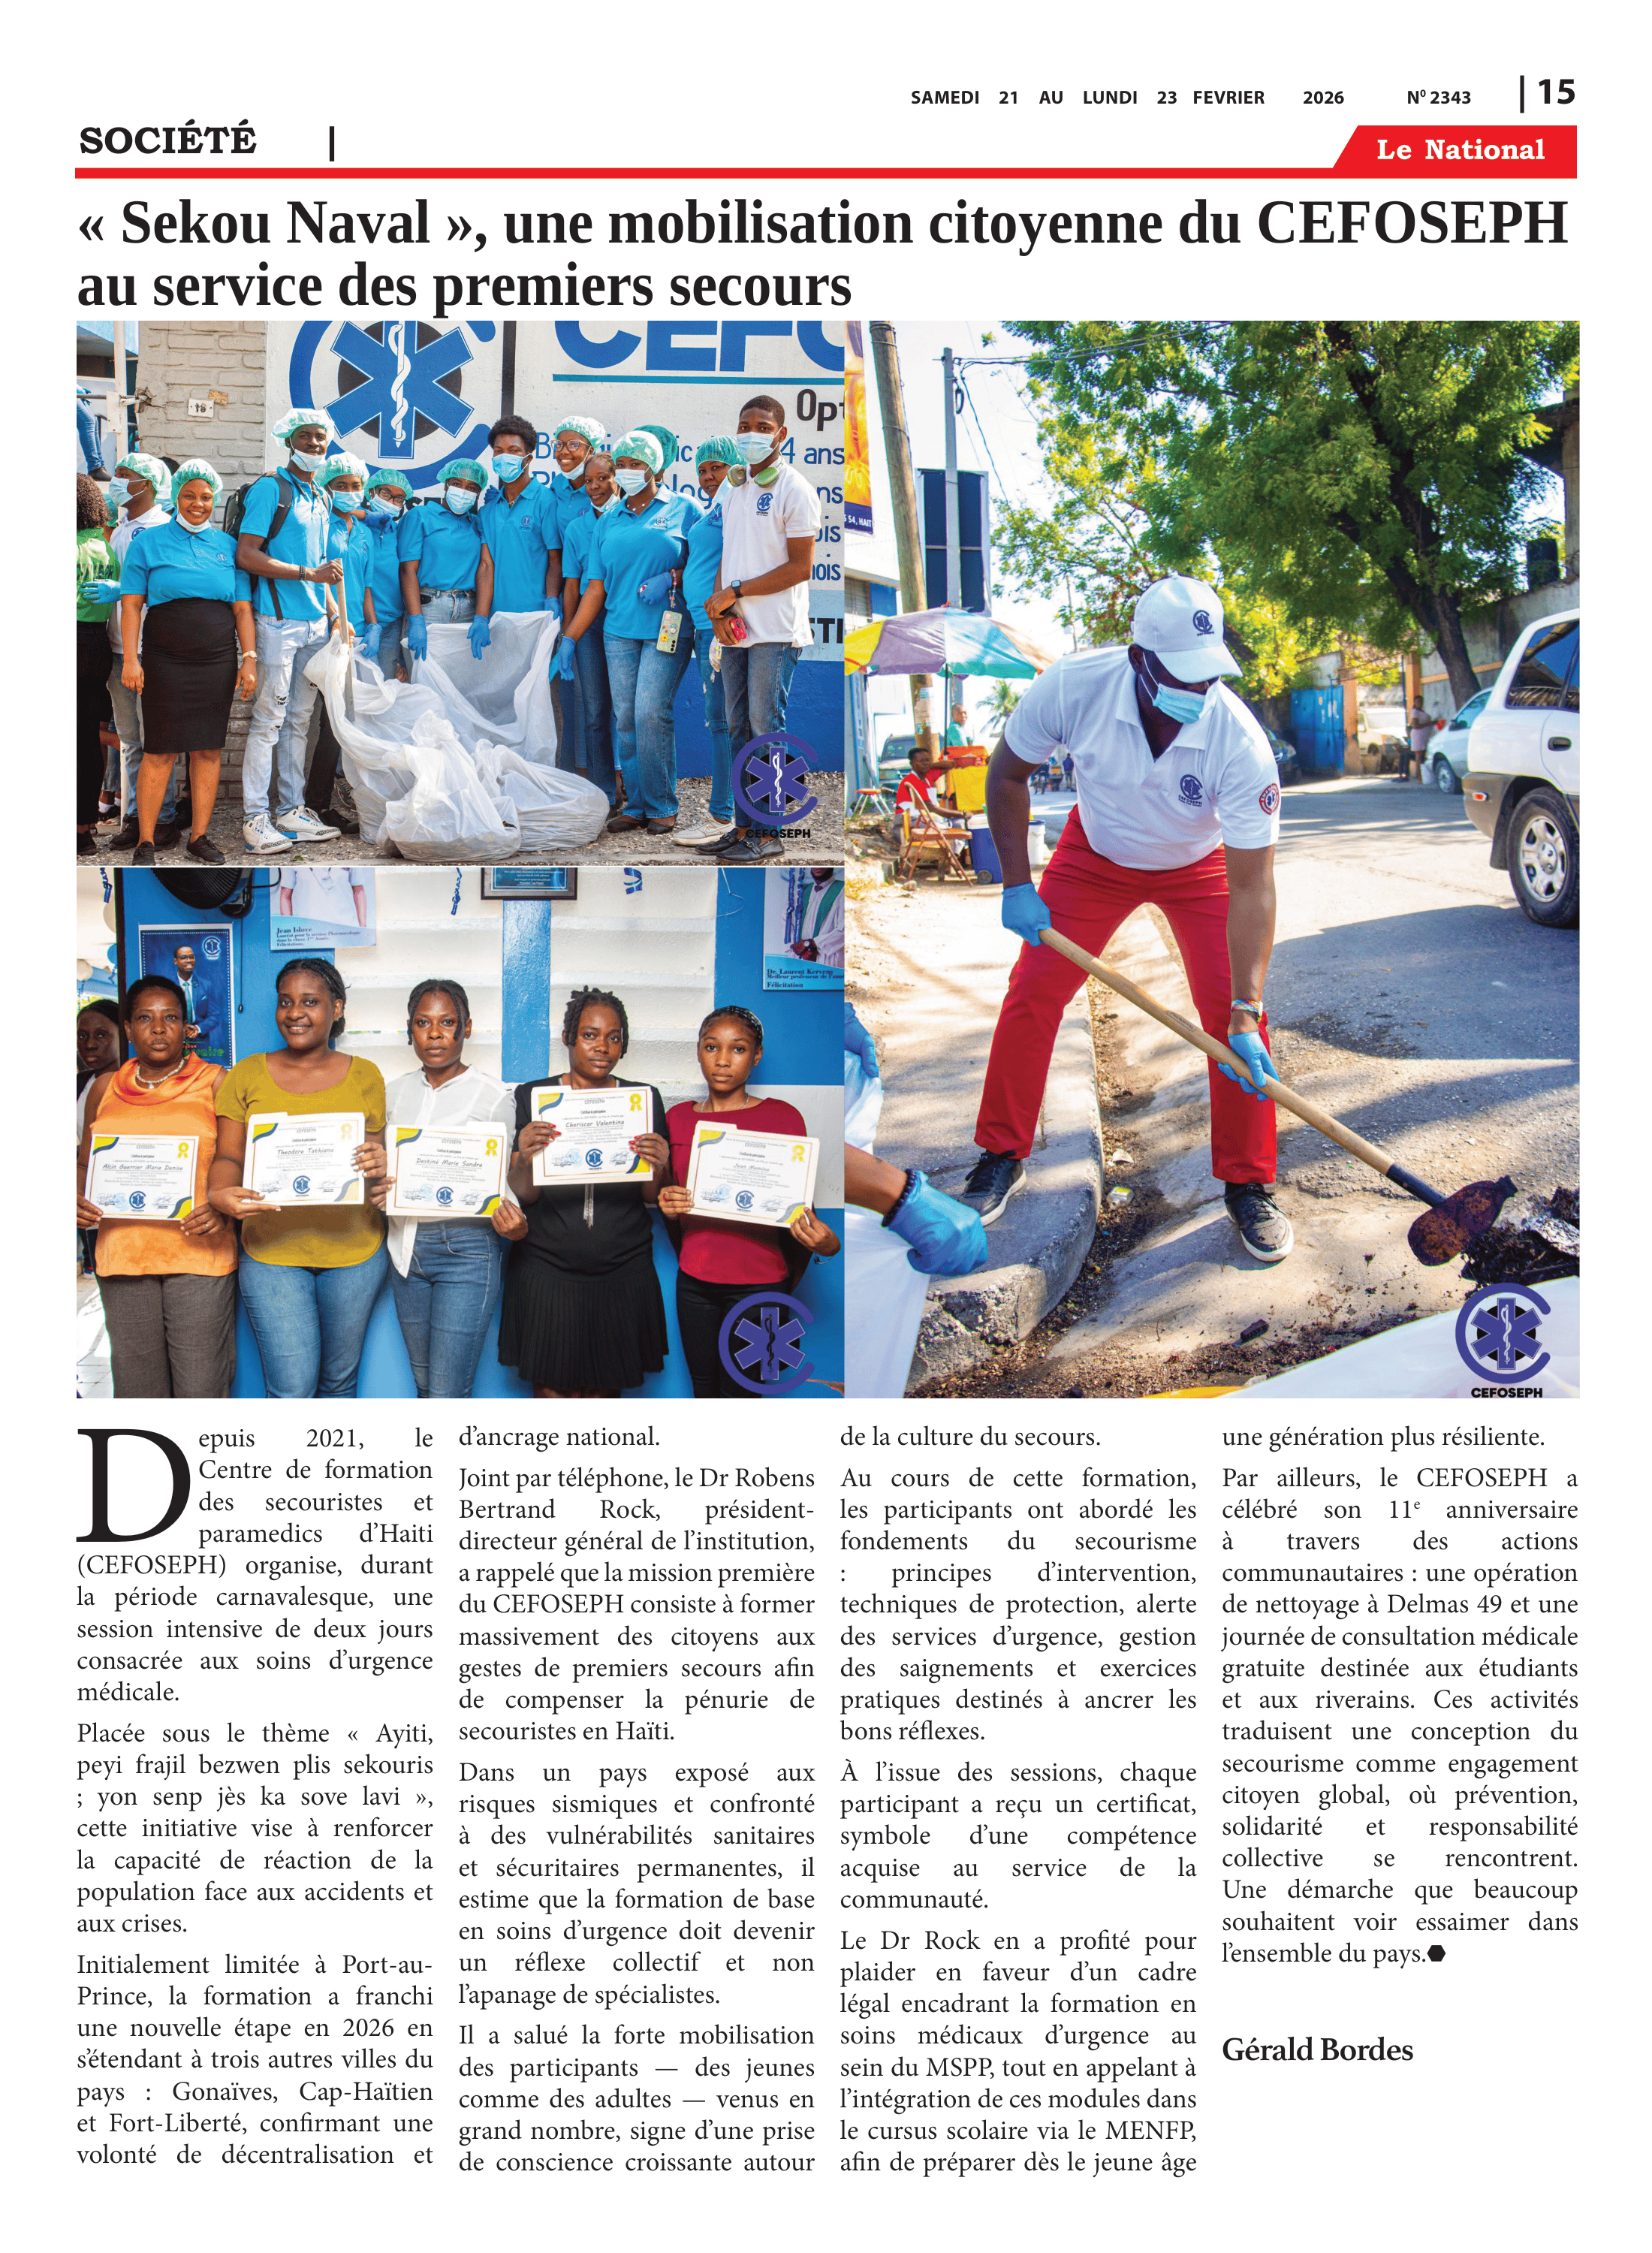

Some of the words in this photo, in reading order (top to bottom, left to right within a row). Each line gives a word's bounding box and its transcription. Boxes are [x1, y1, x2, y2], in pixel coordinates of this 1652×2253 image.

[911, 90, 979, 104] SAMEDI
[999, 91, 1017, 104] 21
[1039, 90, 1063, 104] AU
[1084, 90, 1137, 104] LUNDI
[1157, 91, 1177, 104] 23
[1193, 90, 1265, 104] FEVRIER
[1303, 91, 1345, 104] 2026
[1430, 91, 1471, 104] 2343
[1539, 79, 1575, 104] 15
[80, 119, 258, 155] SOCIÉTÉ
[1377, 139, 1412, 160] Le
[1425, 138, 1545, 160] National
[122, 198, 271, 244] Sekou
[287, 198, 430, 244] Naval
[503, 213, 592, 244] une
[608, 198, 914, 244] mobilisation
[930, 198, 1162, 257] citoyenne
[1179, 198, 1241, 244] du
[1259, 201, 1569, 244] CEFOSEPH
[78, 275, 137, 306] au
[153, 261, 322, 306] service
[339, 261, 417, 306] des
[433, 261, 653, 319] premiers
[670, 275, 852, 306] secours
[803, 446, 845, 466] ans
[815, 486, 843, 505] ns
[858, 517, 875, 528] HAIT
[1222, 1468, 1259, 1487] Par
[1277, 1466, 1361, 1490] ailleurs,
[1379, 1467, 1398, 1487] le
[1417, 1467, 1548, 1487] CEFOSEPH
[1567, 1473, 1578, 1487] a
[459, 1498, 556, 1519] Bertrand
[599, 1498, 661, 1522] Rock,
[704, 1498, 814, 1525] président-
[840, 1529, 968, 1550] fondements
[1007, 1530, 1036, 1550] du
[1075, 1531, 1197, 1550] secourisme
[78, 1554, 226, 1579] (CEFOSEPH)
[246, 1555, 342, 1581] organise,
[360, 1554, 434, 1574] durant
[840, 1592, 957, 1620] techniques
[969, 1593, 994, 1613] de
[1005, 1594, 1124, 1620] protection,
[1137, 1592, 1197, 1613] alerte
[1222, 1593, 1247, 1613] de
[1256, 1597, 1359, 1620] nettoyage
[1367, 1594, 1379, 1613] à
[1387, 1593, 1469, 1613] Delmas
[1476, 1594, 1502, 1613] 49
[1510, 1597, 1530, 1613] et
[1539, 1600, 1578, 1613] une
[77, 1721, 145, 1742] Placée
[162, 1729, 210, 1742] sous
[227, 1721, 245, 1742] le
[262, 1721, 330, 1742] thème
[375, 1723, 433, 1749] Ayiti,
[459, 1825, 471, 1844] à
[490, 1824, 526, 1844] des
[546, 1823, 692, 1844] vulnérabilités
[713, 1826, 815, 1844] sanitaires
[840, 1889, 988, 1908] communauté.
[1222, 1880, 1267, 1899] Une
[1287, 1878, 1394, 1899] démarche
[1414, 1885, 1453, 1905] que
[1473, 1878, 1578, 1905] beaucoup
[77, 1953, 210, 1974] Initialement
[225, 1953, 300, 1974] limitée
[315, 1954, 327, 1974] à
[342, 1955, 433, 1974] Port-au-
[459, 2024, 475, 2044] Il
[489, 2031, 500, 2044] a
[514, 2023, 568, 2044] salué
[581, 2024, 601, 2044] la
[614, 2023, 665, 2044] forte
[679, 2023, 815, 2044] mobilisation
[1222, 2036, 1314, 2061] Gérald
[1320, 2036, 1414, 2061] Bordes
[77, 2116, 97, 2132] et
[109, 2111, 247, 2135] Fort-Liberté,
[260, 2111, 381, 2132] confirmant
[393, 2119, 433, 2132] une
[459, 2151, 484, 2171] de
[496, 2152, 613, 2171] conscience
[625, 2152, 732, 2171] croissante
[744, 2154, 815, 2171] autour
